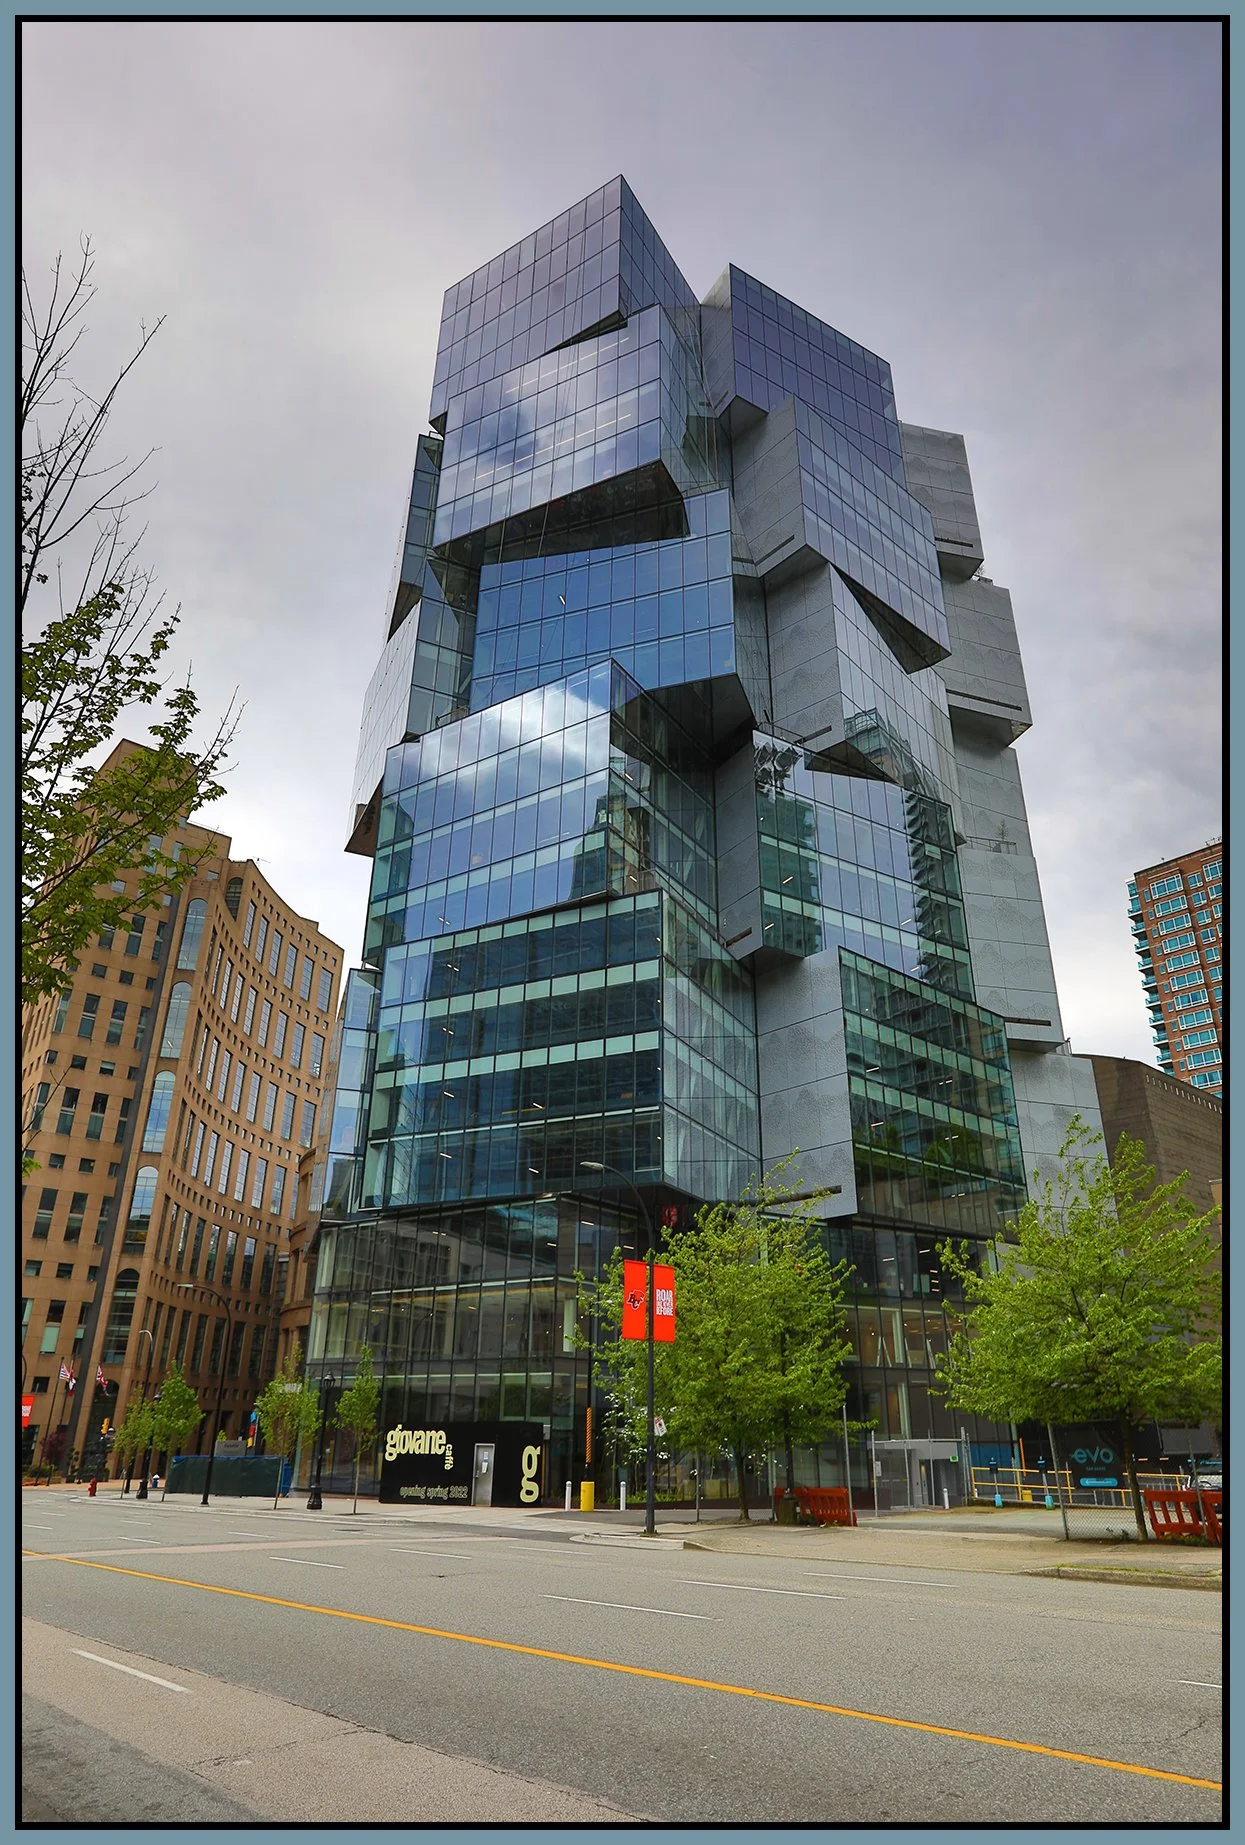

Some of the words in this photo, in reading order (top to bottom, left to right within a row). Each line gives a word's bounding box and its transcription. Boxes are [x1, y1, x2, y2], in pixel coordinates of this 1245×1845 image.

[656, 1289, 673, 1301] ROAR
[384, 1424, 447, 1462] giovane
[1071, 1445, 1114, 1464] evo
[519, 1445, 541, 1503] g
[399, 1484, 427, 1499] opening
[426, 1485, 449, 1500] spring
[449, 1485, 469, 1499] 2022
